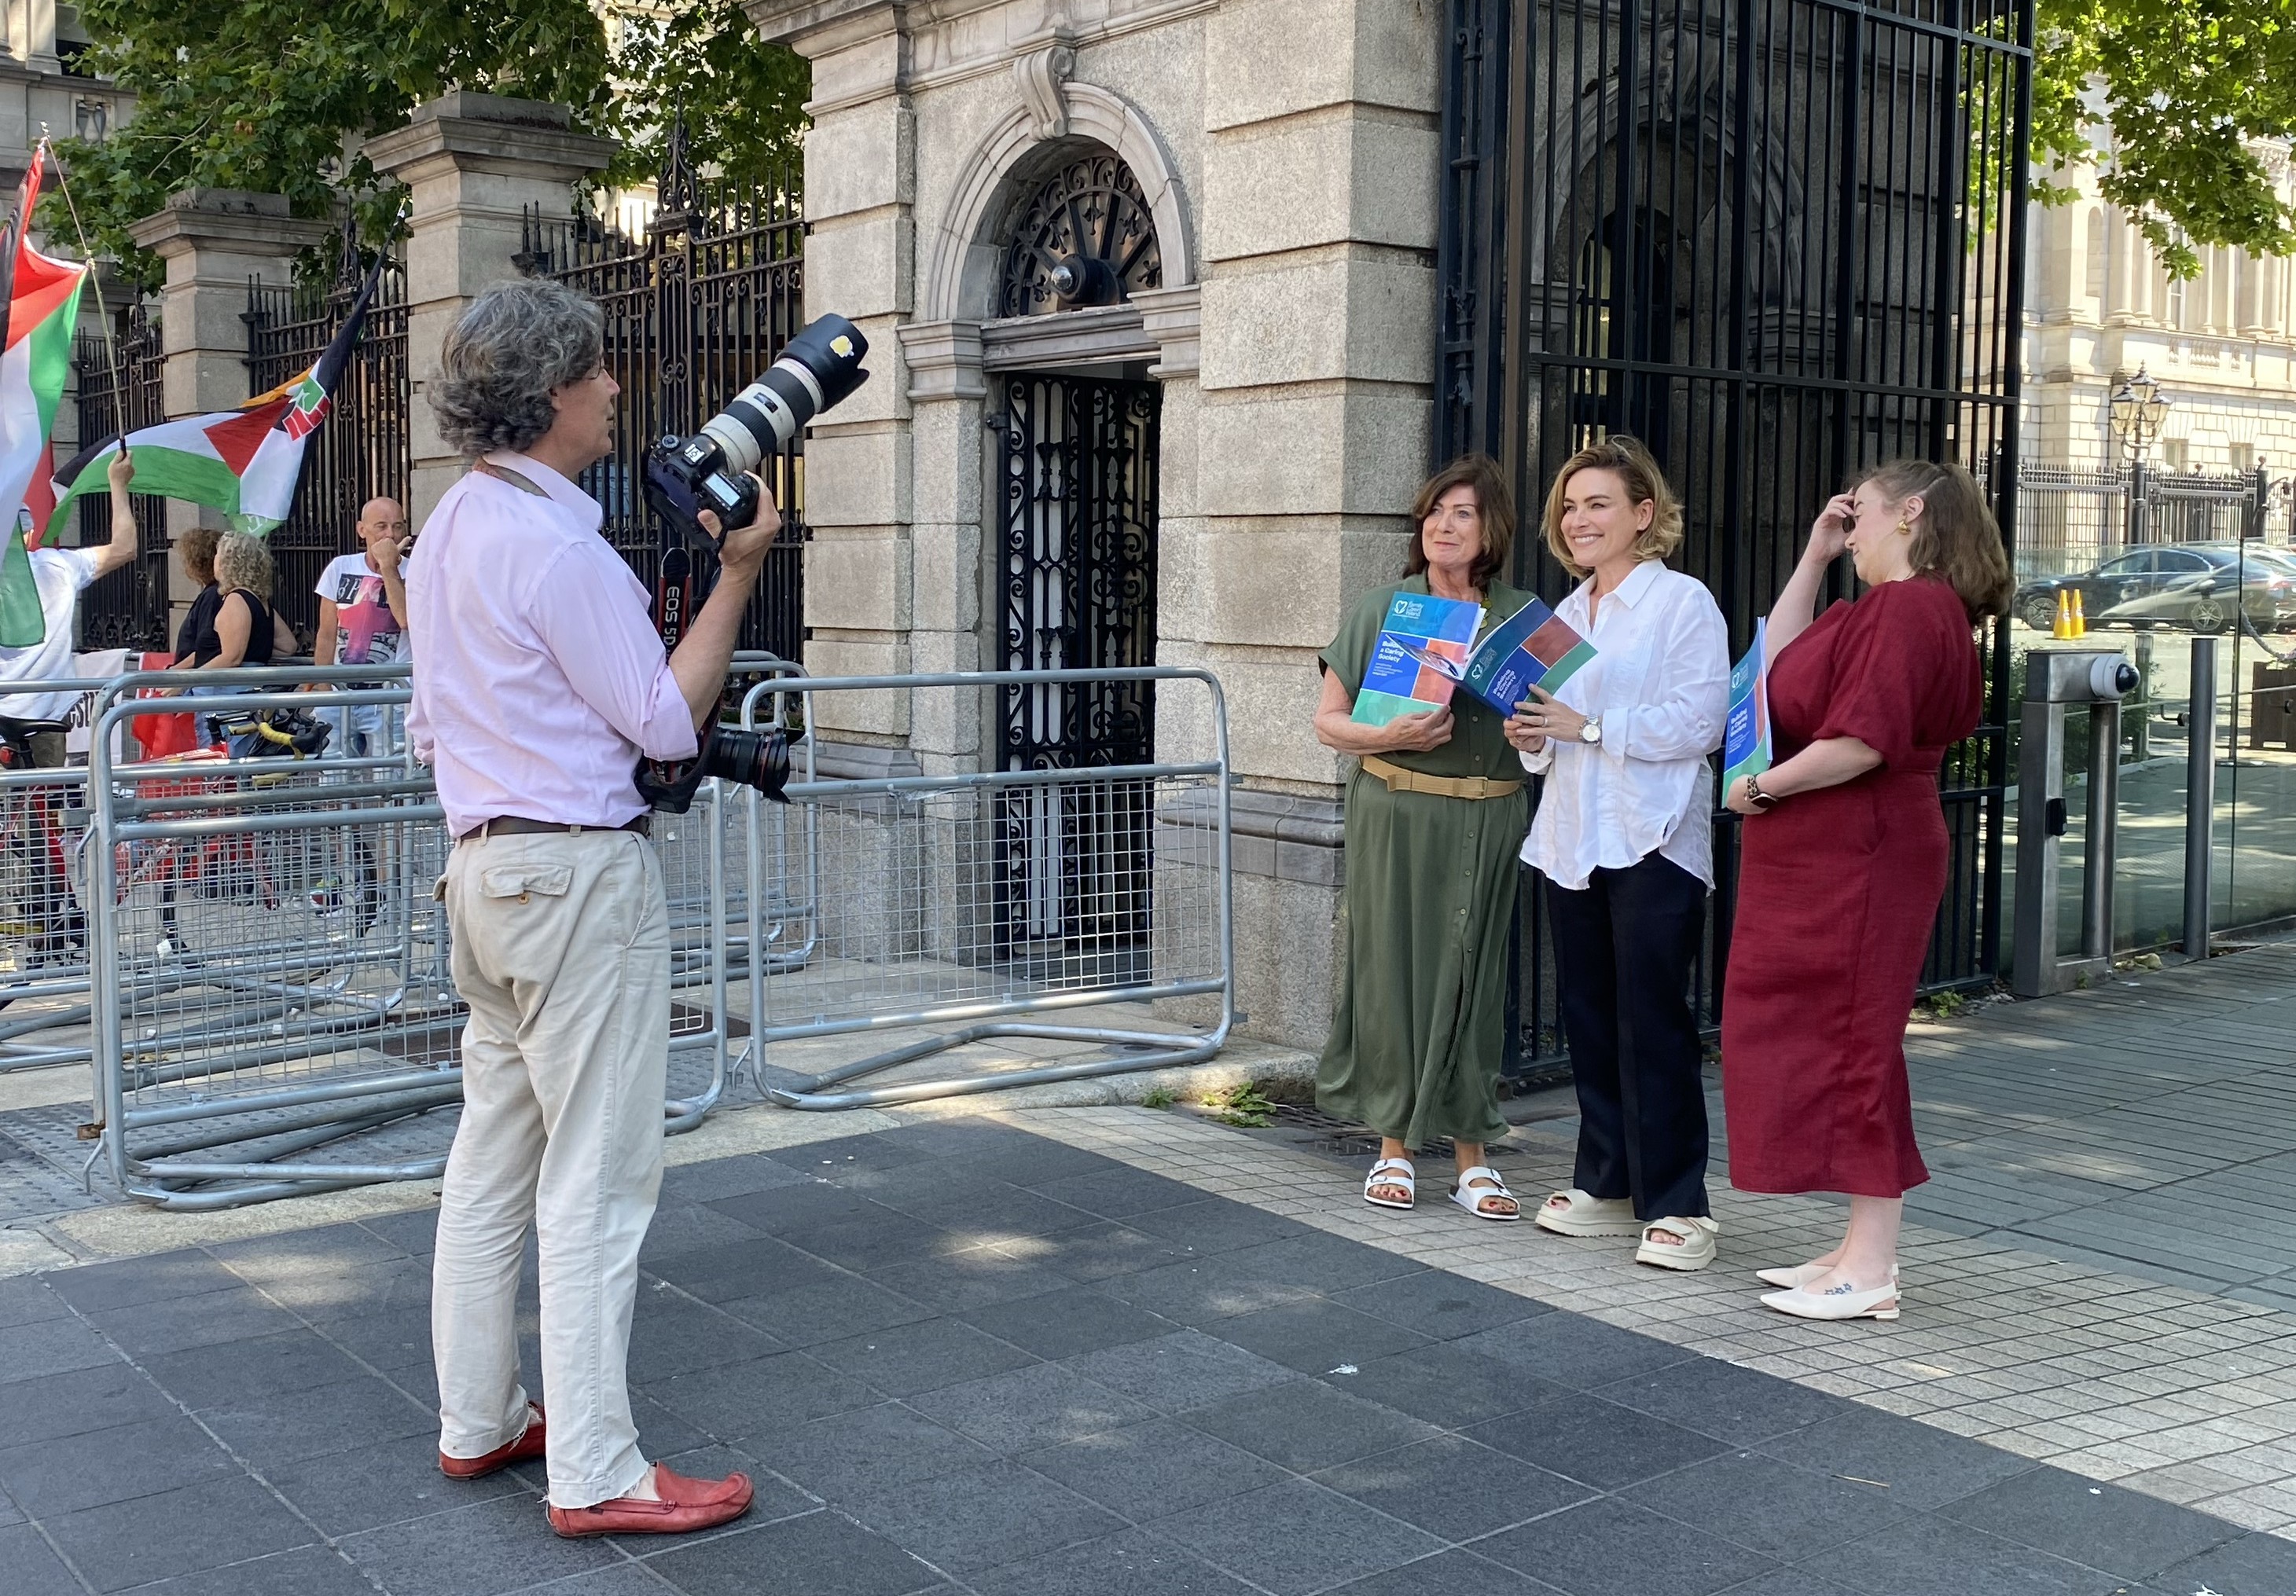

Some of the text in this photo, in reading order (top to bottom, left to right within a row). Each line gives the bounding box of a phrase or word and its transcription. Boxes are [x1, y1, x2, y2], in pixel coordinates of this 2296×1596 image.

[663, 586, 680, 645] EOS 5D
[1378, 653, 1401, 663] Society
[1384, 648, 1405, 658] Caring
[1493, 669, 1511, 695] Building
[1499, 675, 1516, 699] Society
